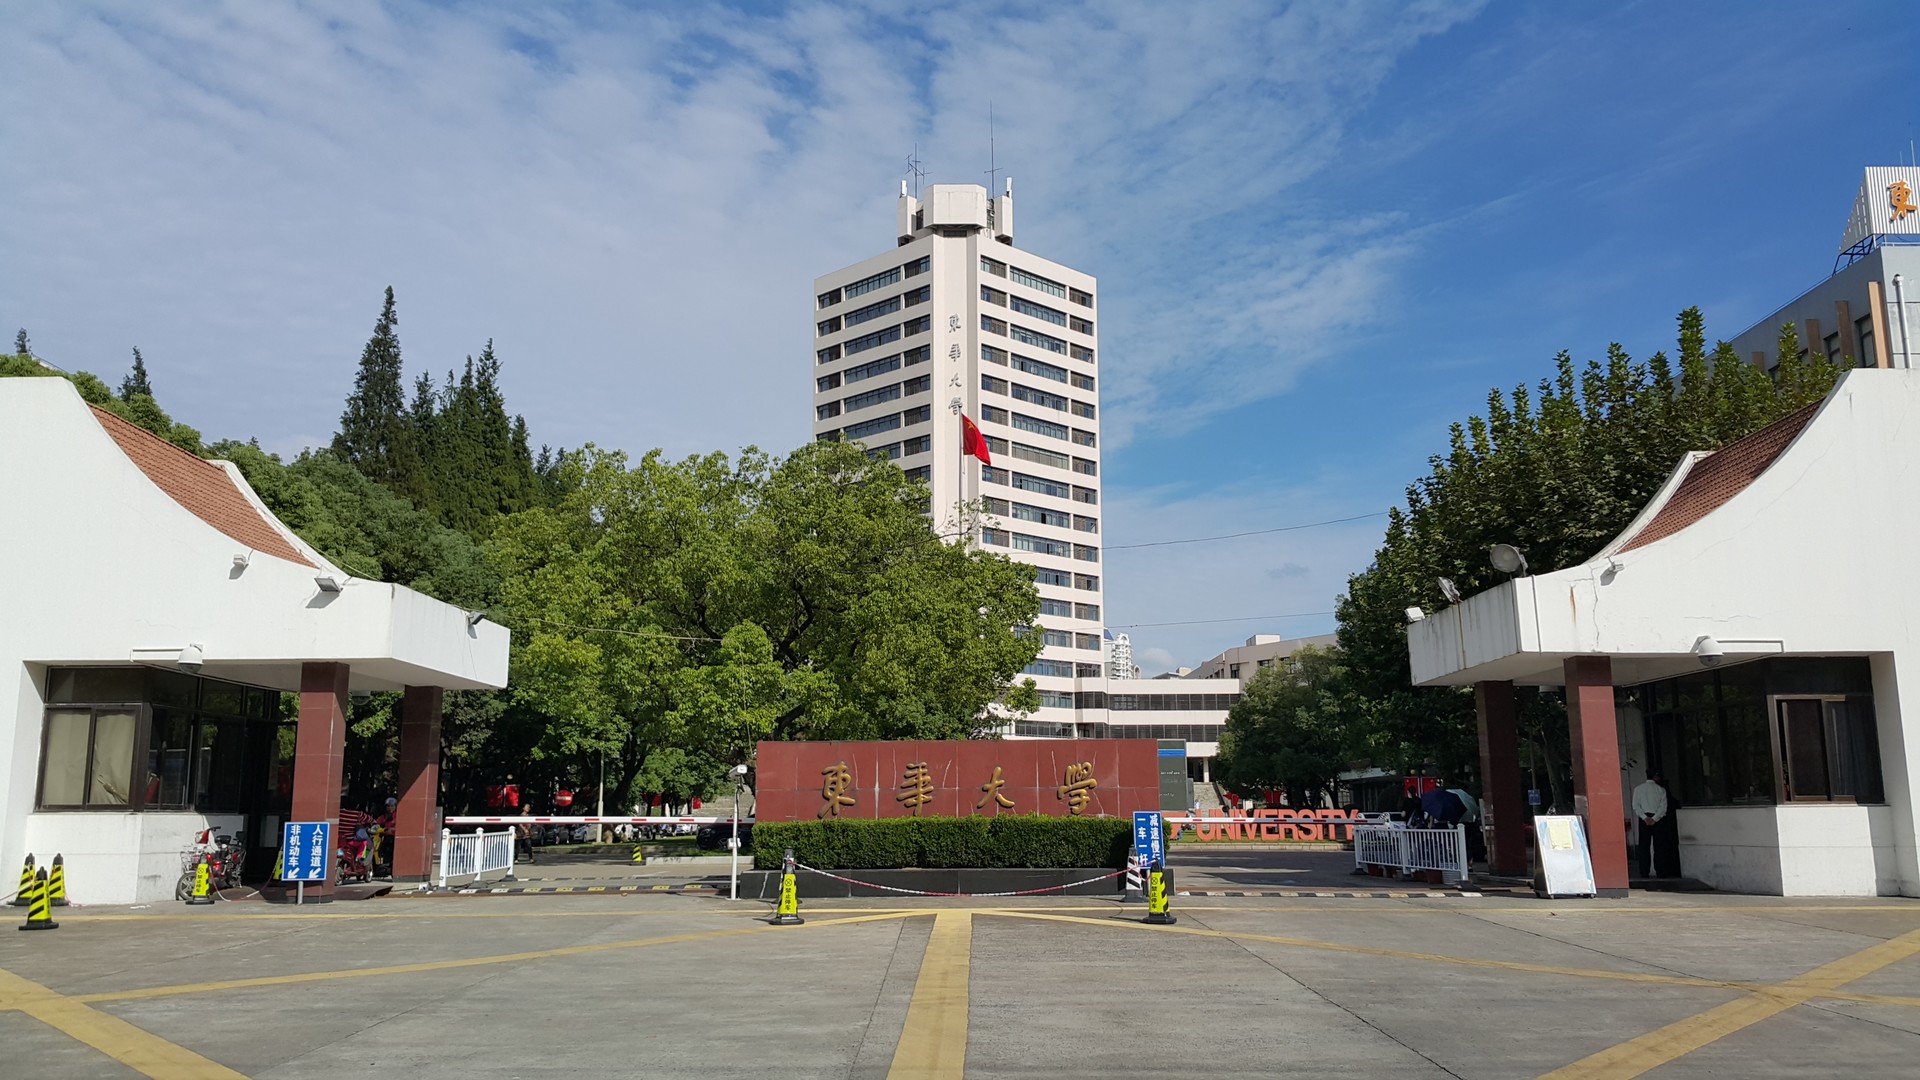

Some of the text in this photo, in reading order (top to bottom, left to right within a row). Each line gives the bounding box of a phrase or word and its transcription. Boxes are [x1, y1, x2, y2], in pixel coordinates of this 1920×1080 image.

[288, 824, 302, 868] 非机动车
[310, 824, 324, 867] 人行通道
[1137, 817, 1149, 867] 一车一杆
[1195, 808, 1359, 841] UNIVERSITY
